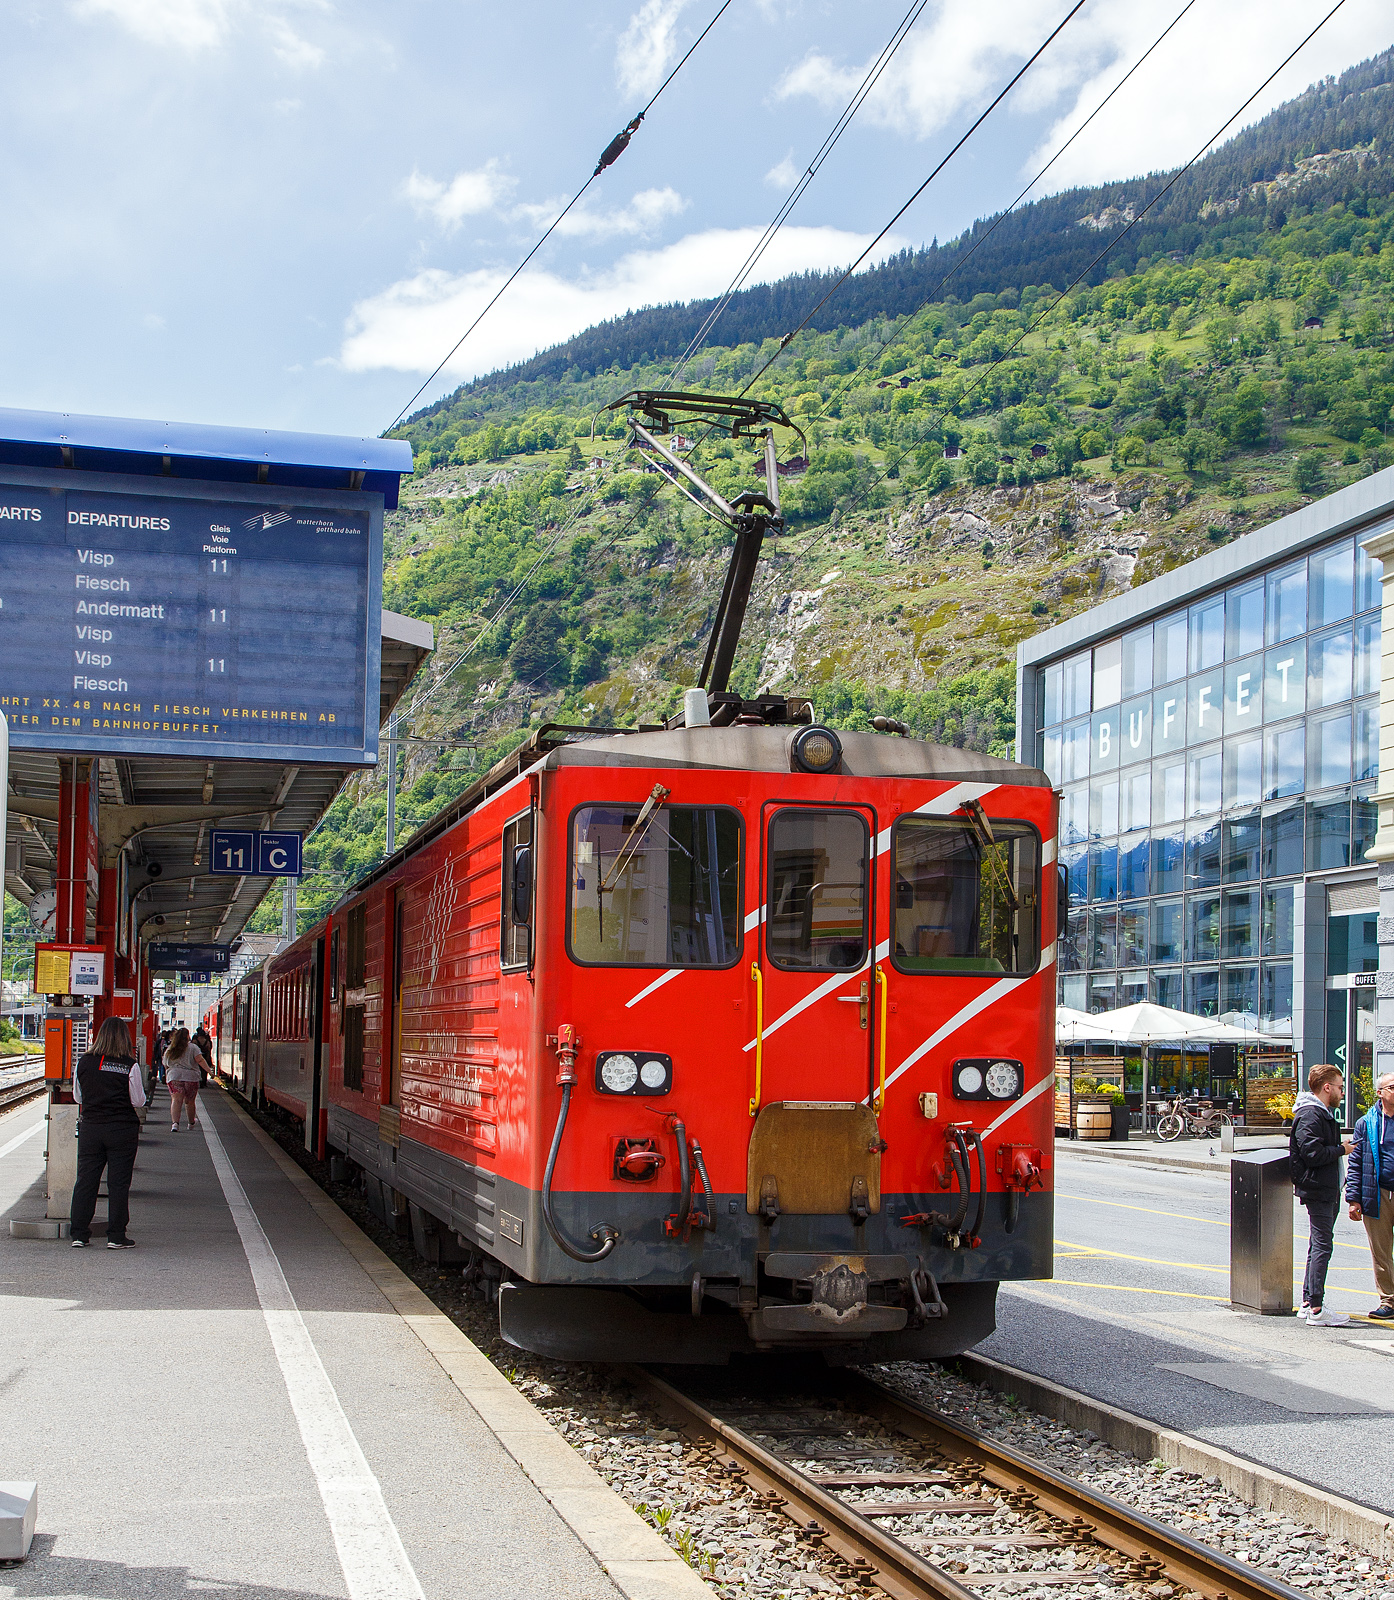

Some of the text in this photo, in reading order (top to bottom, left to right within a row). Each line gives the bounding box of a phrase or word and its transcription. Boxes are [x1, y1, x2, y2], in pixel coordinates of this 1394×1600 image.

[0, 506, 42, 522] ARTS
[68, 511, 171, 531] DEPARTURES
[296, 518, 334, 527] matterhorn
[210, 524, 231, 534] Gleis
[315, 525, 361, 535] gotthard bahn
[211, 535, 229, 544] Voie
[203, 544, 237, 555] Platform
[77, 549, 228, 573] Visp 11
[75, 575, 130, 592] Fiesch
[76, 600, 227, 624] Andermatt 11
[76, 625, 113, 643] Visp
[75, 650, 226, 673] Visp 11
[74, 675, 128, 692] Fiesch
[43, 698, 91, 710] XX.48
[103, 702, 141, 712] NACH
[153, 704, 210, 716] FIESCH
[222, 708, 308, 721] VERKEHREN
[318, 713, 336, 722] AB
[1099, 658, 1294, 758] BUFFET
[51, 716, 81, 727] DEM
[93, 719, 227, 734] BAHNHOFBUFFET.
[222, 848, 244, 868] 11
[269, 848, 287, 869] C
[216, 952, 225, 961] 11
